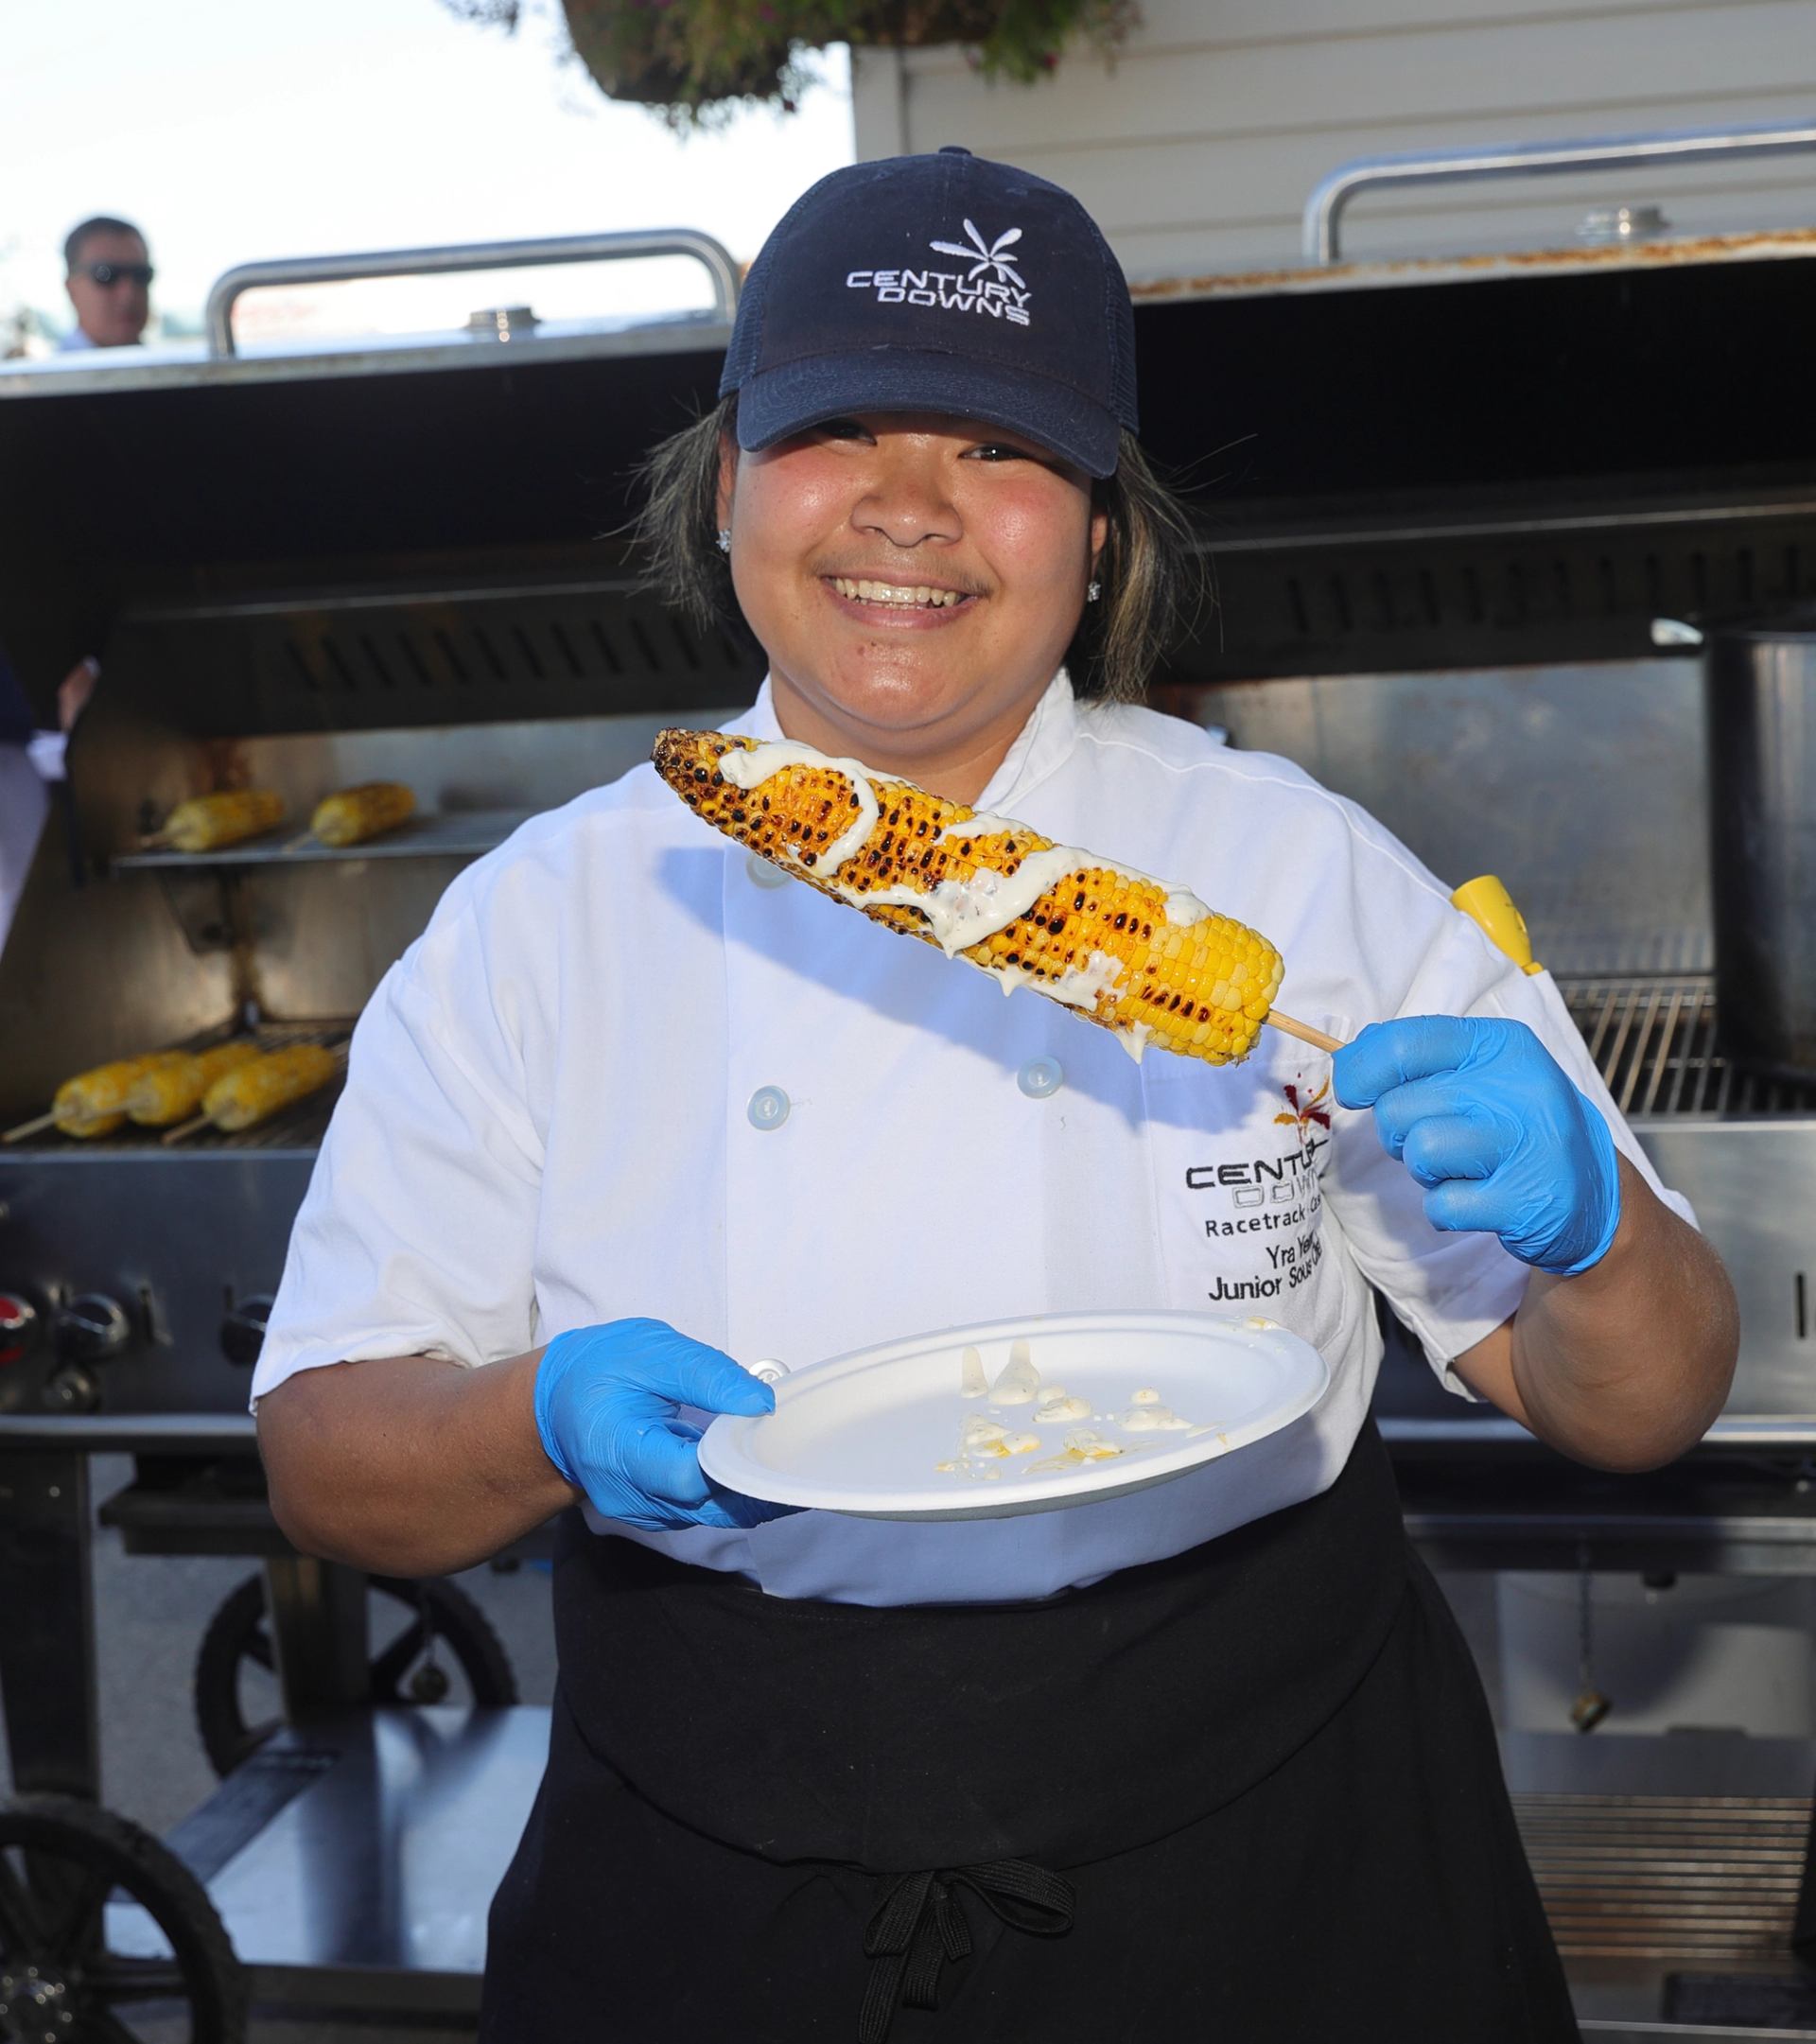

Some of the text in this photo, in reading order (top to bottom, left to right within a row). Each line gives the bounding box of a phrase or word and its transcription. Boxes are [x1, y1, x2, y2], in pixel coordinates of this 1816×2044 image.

[847, 269, 1033, 307] CENTURY
[877, 288, 1030, 325] DOWNS
[1205, 1203, 1306, 1237] Racetrack
[1266, 1244, 1295, 1269] Yra
[1208, 1275, 1283, 1301] Junior
